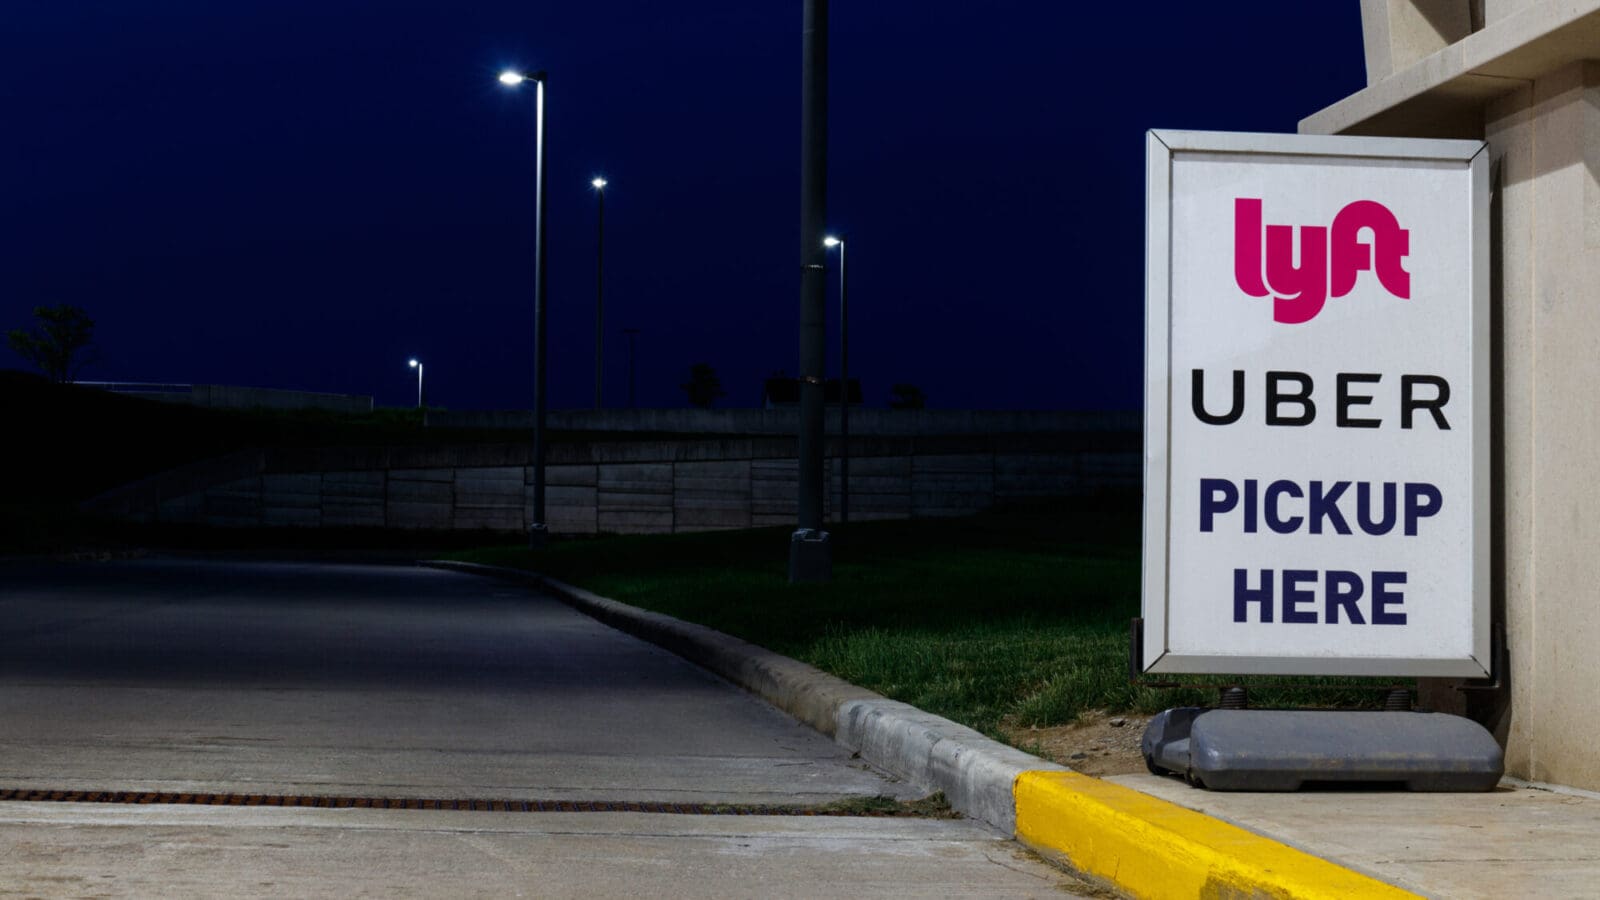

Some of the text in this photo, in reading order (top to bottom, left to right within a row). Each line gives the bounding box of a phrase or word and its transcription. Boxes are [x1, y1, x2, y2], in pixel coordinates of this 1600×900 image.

[1234, 198, 1411, 325] lyft
[1191, 369, 1452, 430] UBER
[1199, 478, 1443, 537] PICKUP
[1233, 568, 1408, 626] HERE
